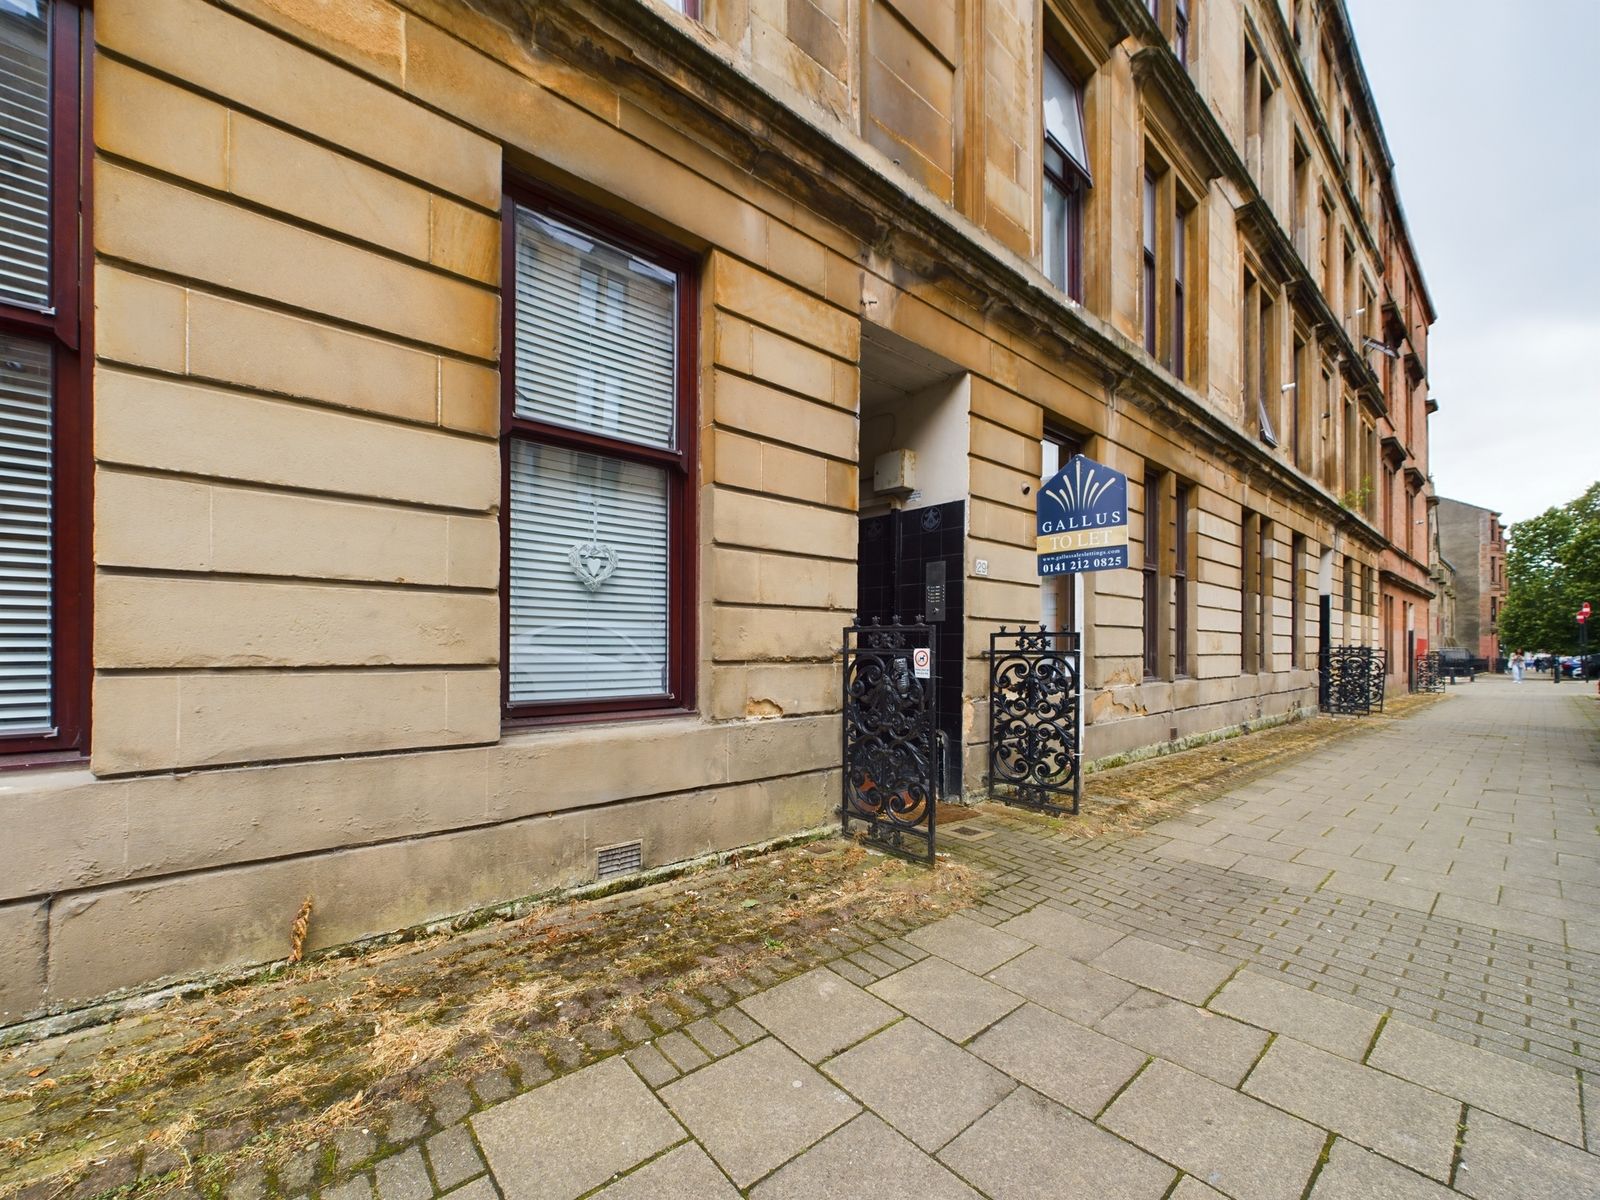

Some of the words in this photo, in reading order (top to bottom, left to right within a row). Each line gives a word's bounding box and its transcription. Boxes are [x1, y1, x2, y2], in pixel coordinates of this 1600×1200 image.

[1042, 511, 1121, 533] GALLUS
[1050, 535, 1072, 550] TO
[1078, 530, 1113, 547] LET
[1043, 549, 1120, 561] www.gallussaleslettings.com
[976, 561, 987, 573] 29
[1043, 562, 1066, 573] 0141
[1070, 559, 1089, 570] 212
[1093, 556, 1122, 568] 0825
